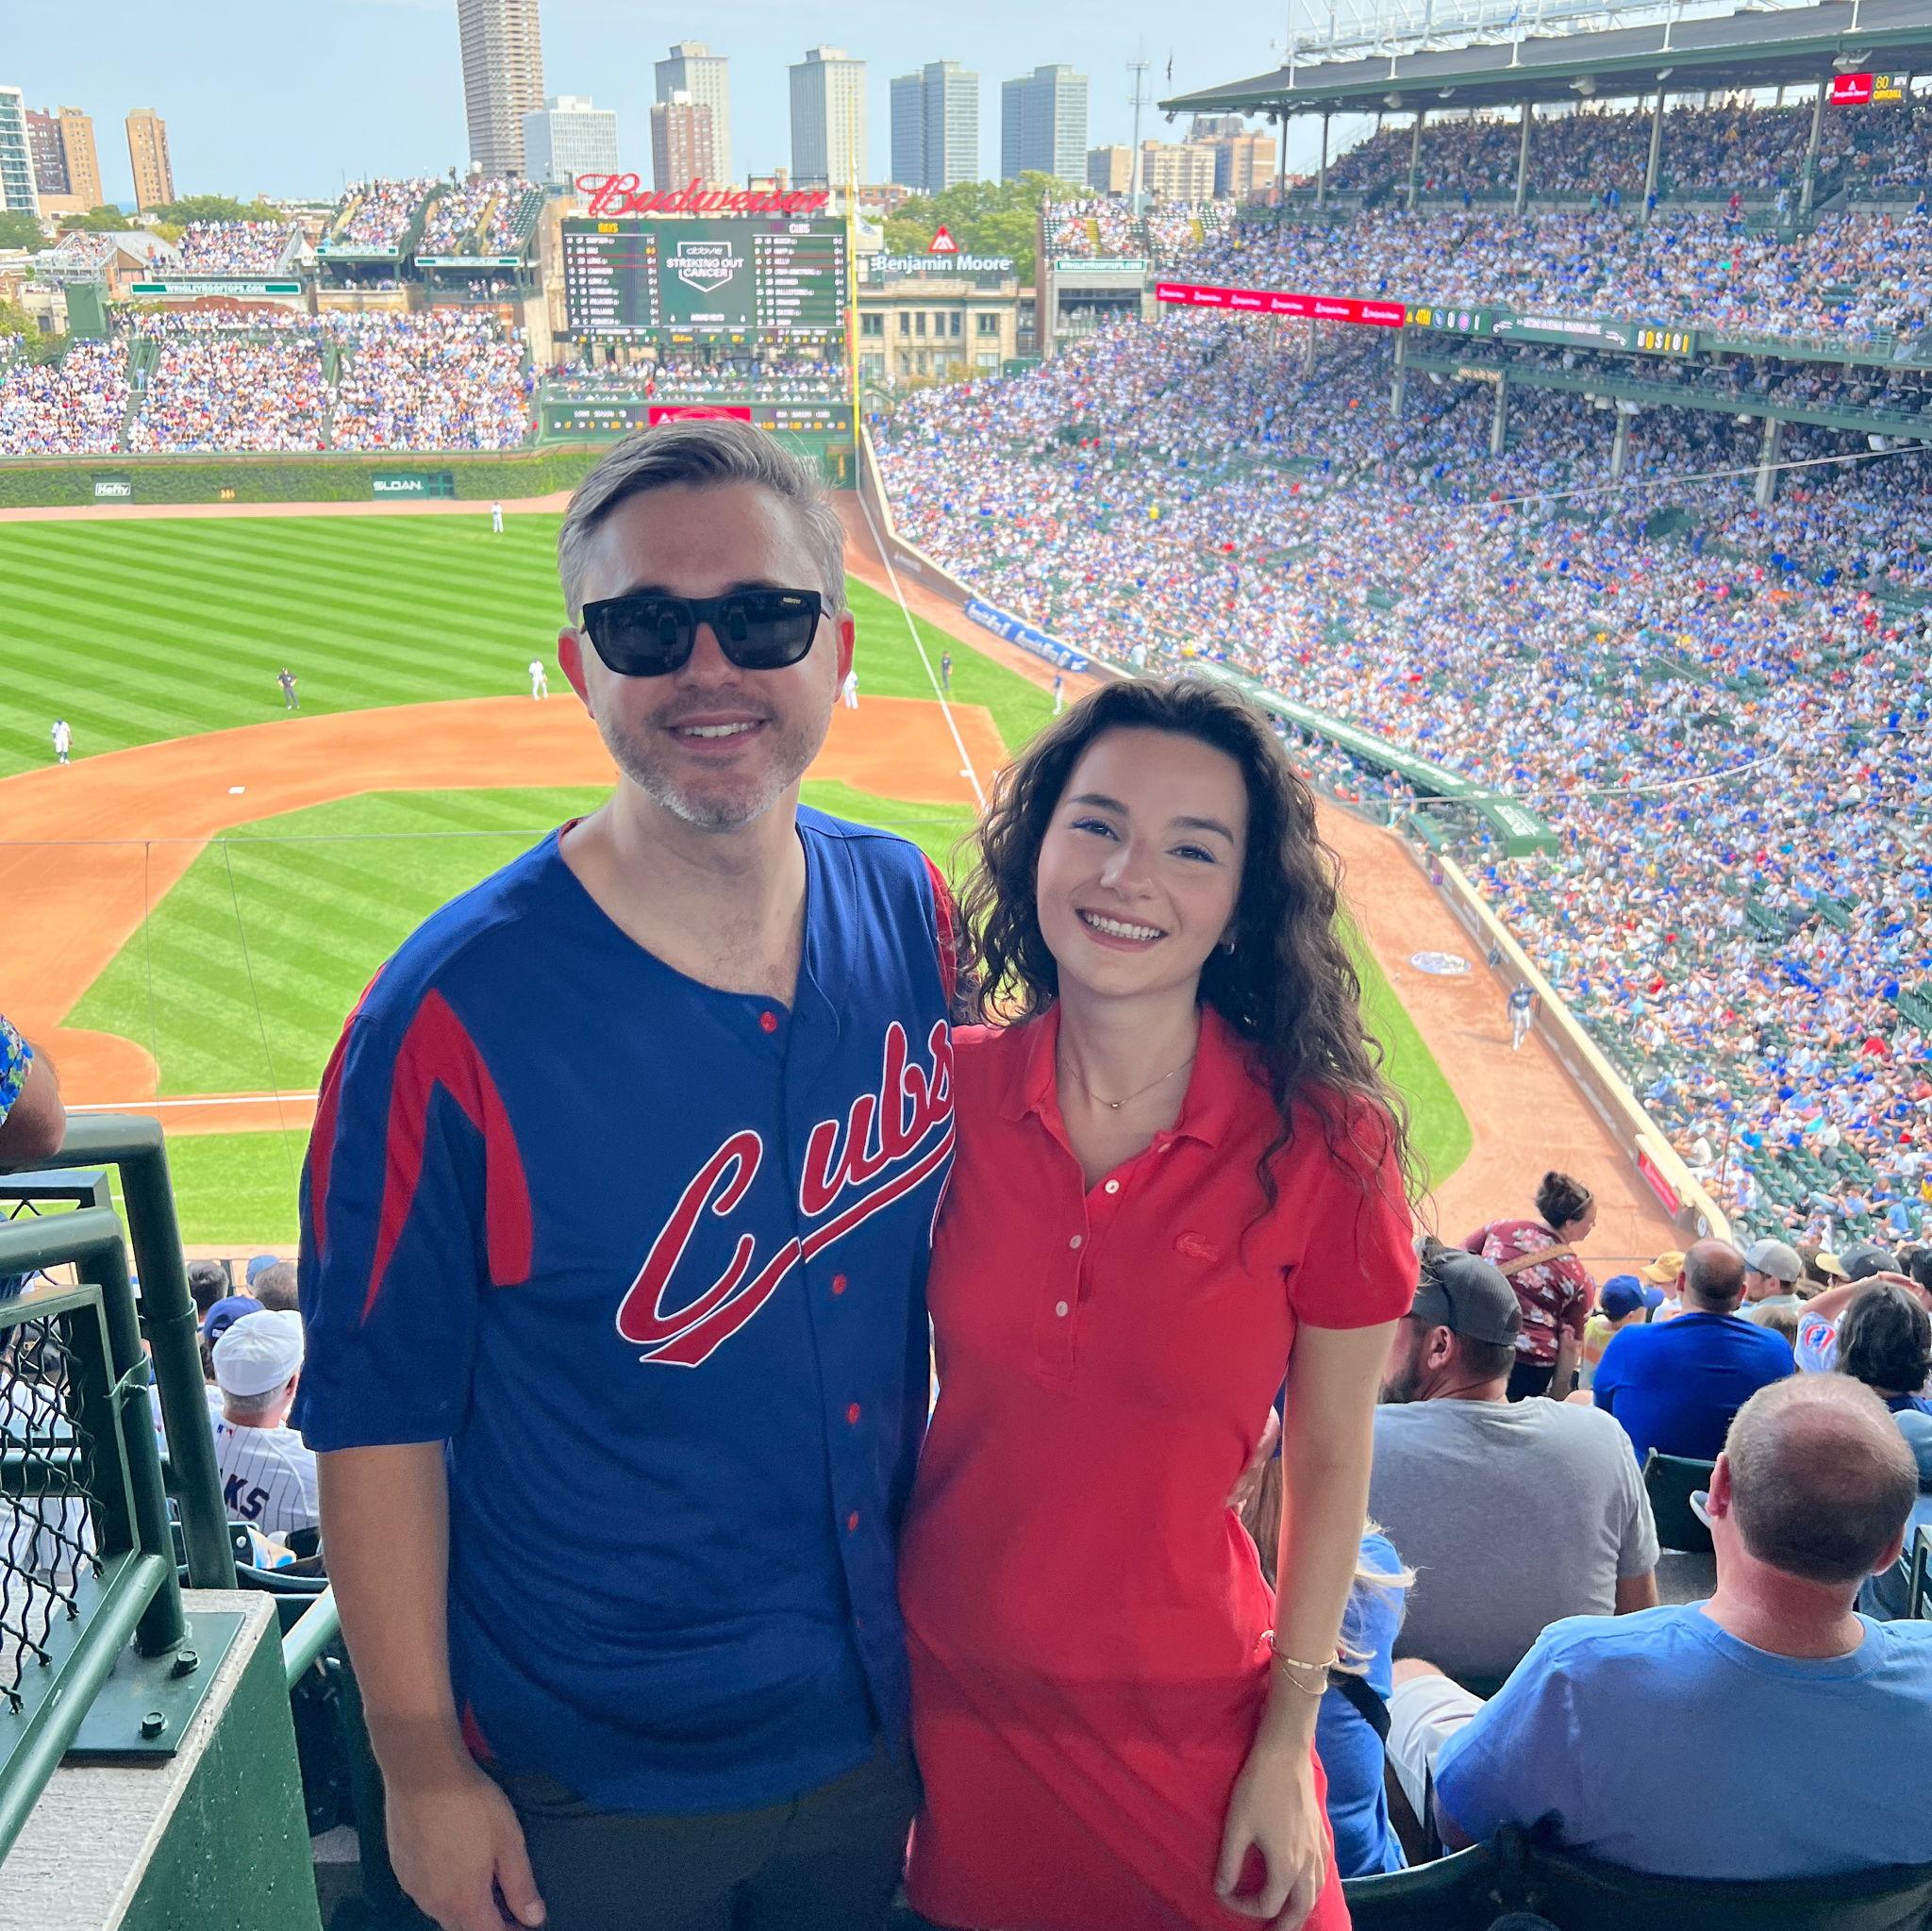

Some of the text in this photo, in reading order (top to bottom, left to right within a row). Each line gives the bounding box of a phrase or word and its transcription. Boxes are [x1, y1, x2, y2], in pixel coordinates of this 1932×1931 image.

[1875, 75, 1890, 90] 80
[575, 173, 831, 217] Budweiser
[666, 258, 744, 269] STRIKING OUT
[874, 255, 1010, 275] Benjamin Moore
[683, 268, 728, 278] CANCER
[97, 484, 129, 496] Hefty
[373, 480, 422, 491] SLOAN
[616, 1019, 957, 1346] Cubs
[221, 1469, 270, 1521] KS
